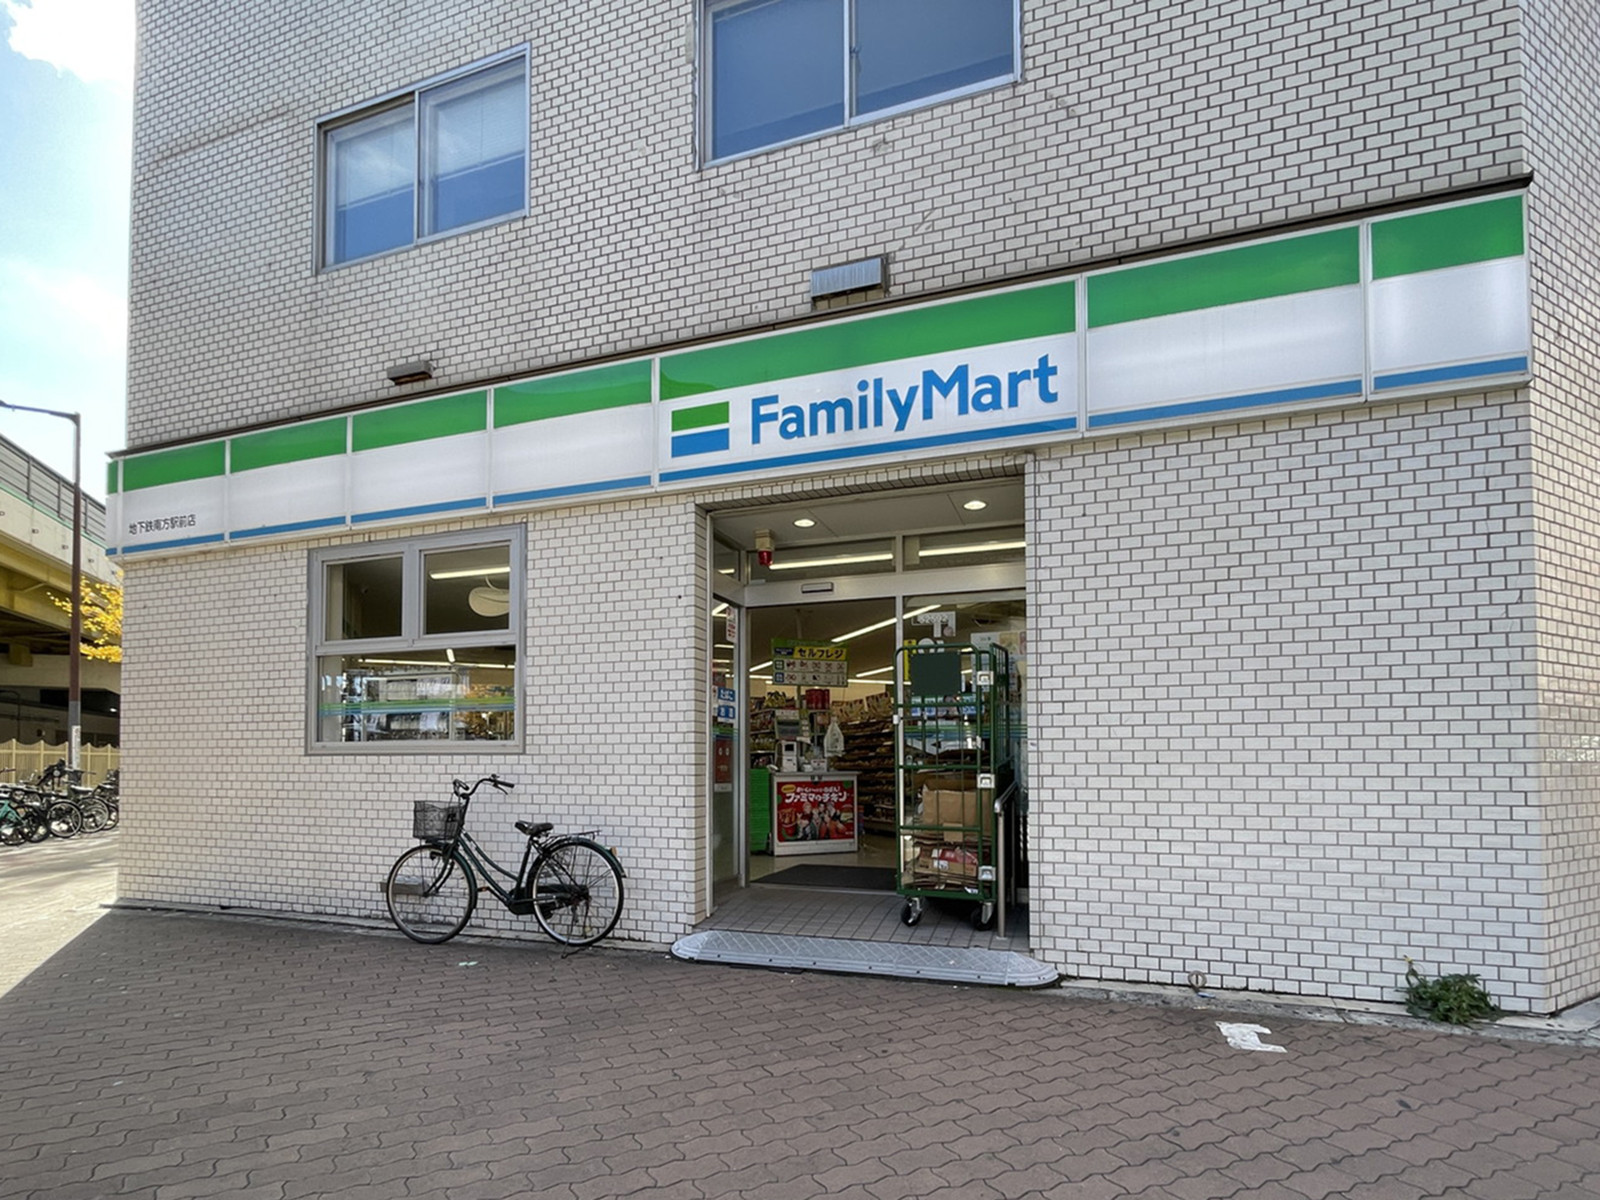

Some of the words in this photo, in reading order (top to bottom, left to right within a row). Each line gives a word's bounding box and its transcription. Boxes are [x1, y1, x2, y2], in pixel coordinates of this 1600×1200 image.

[751, 354, 1059, 445] FamilyMart
[798, 648, 844, 659] セルフレジ
[784, 791, 848, 803] ファミマのチキン
